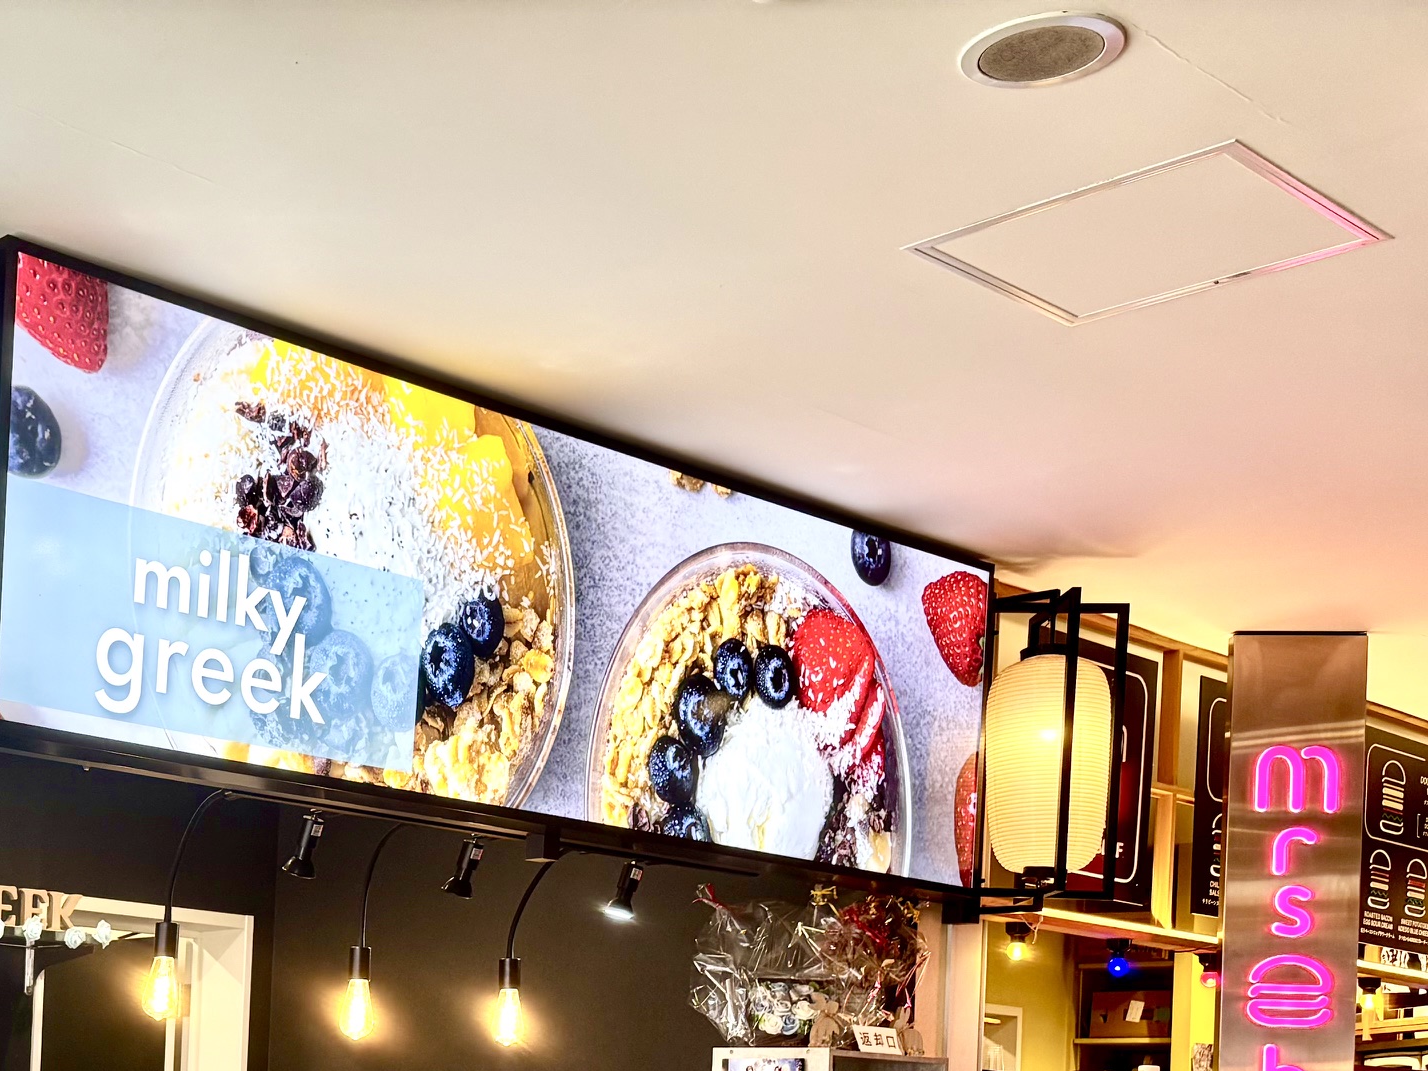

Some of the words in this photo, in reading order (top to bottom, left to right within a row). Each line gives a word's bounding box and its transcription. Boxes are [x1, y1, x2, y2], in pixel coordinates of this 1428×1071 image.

[134, 549, 307, 655] milky
[94, 627, 328, 725] greek
[859, 1031, 898, 1050] 返却口
